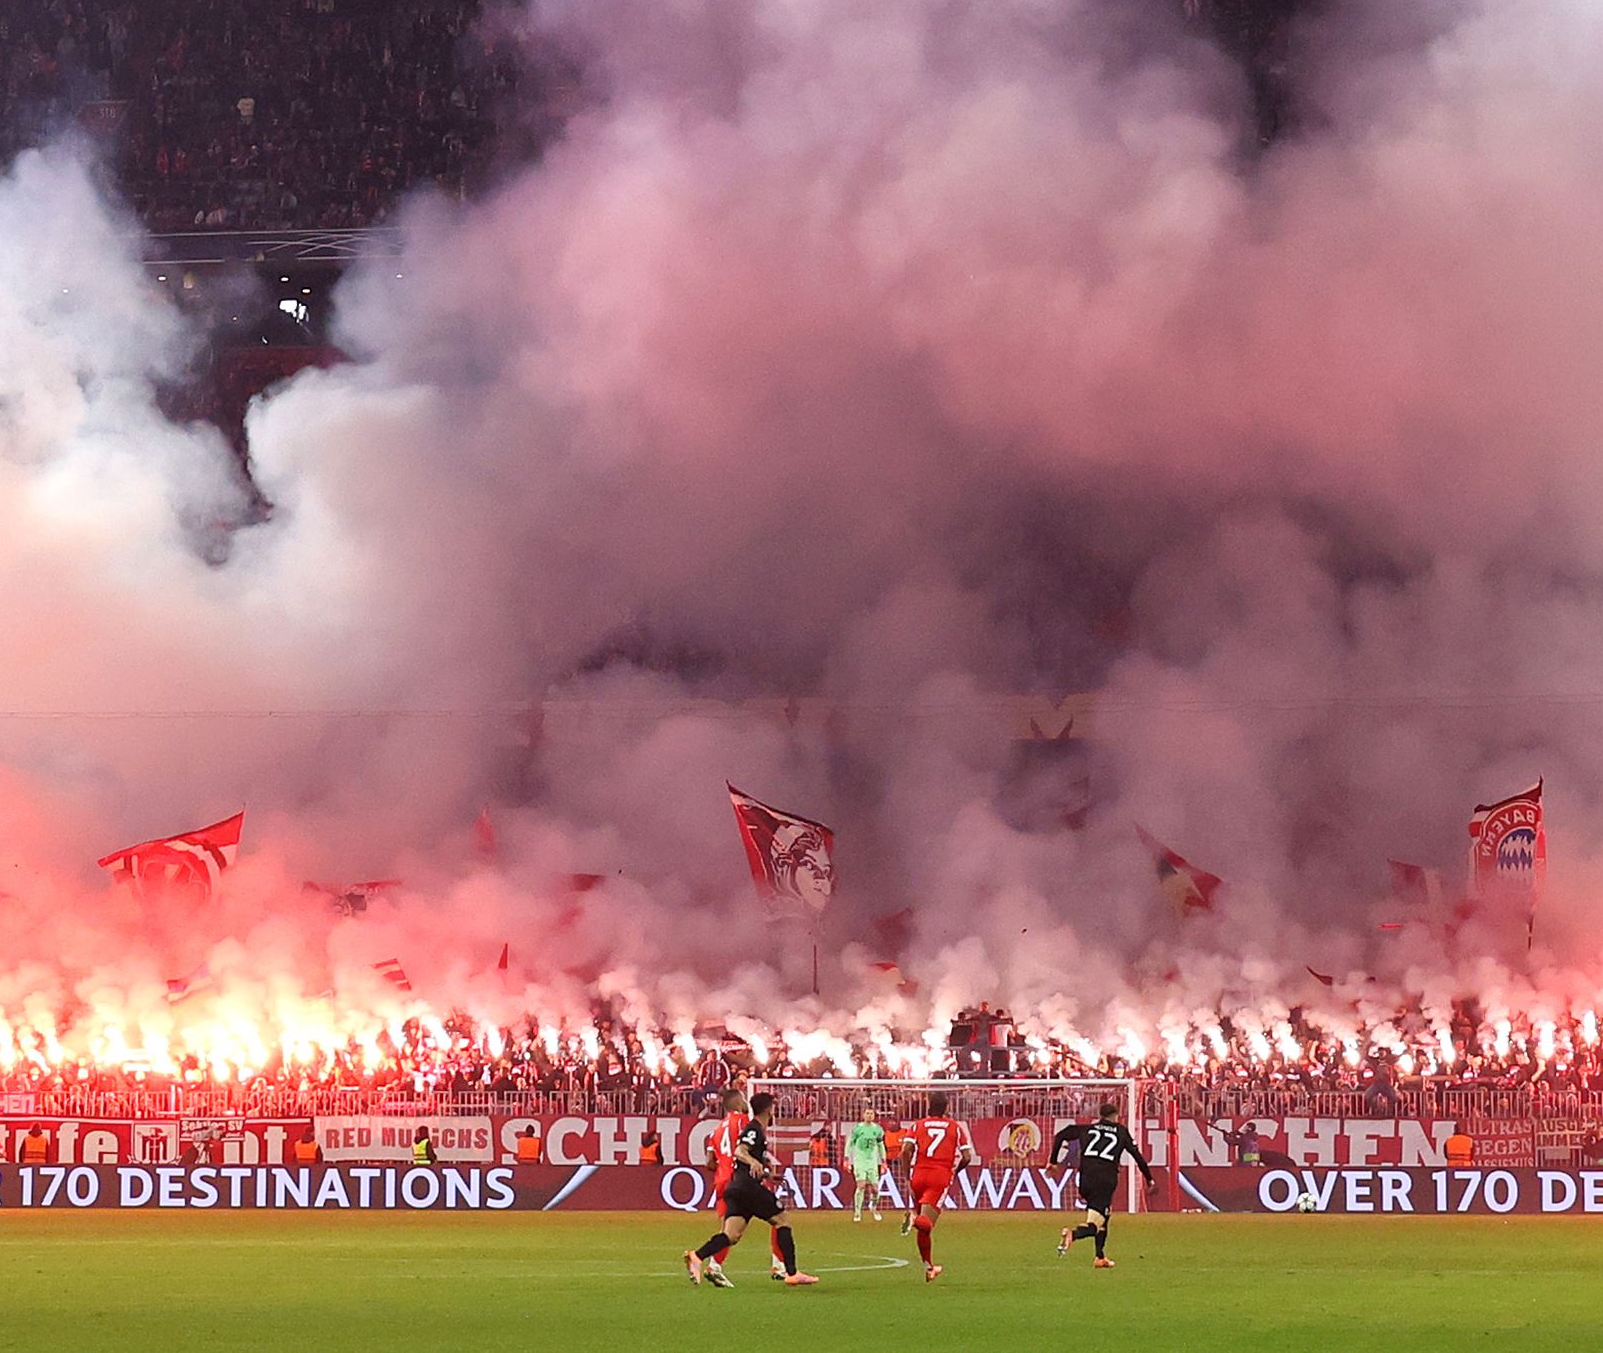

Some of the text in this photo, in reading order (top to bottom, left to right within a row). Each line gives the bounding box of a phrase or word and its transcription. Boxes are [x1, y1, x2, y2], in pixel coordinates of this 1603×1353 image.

[326, 1128, 372, 1149] RED
[1466, 1118, 1533, 1136] ULTRAS
[927, 1128, 946, 1158] 7
[1084, 1129, 1118, 1161] 22
[18, 1166, 100, 1208] 170
[116, 1166, 516, 1209] DESTINATIONS
[1258, 1169, 1414, 1213] OVER
[1432, 1171, 1520, 1213] 170
